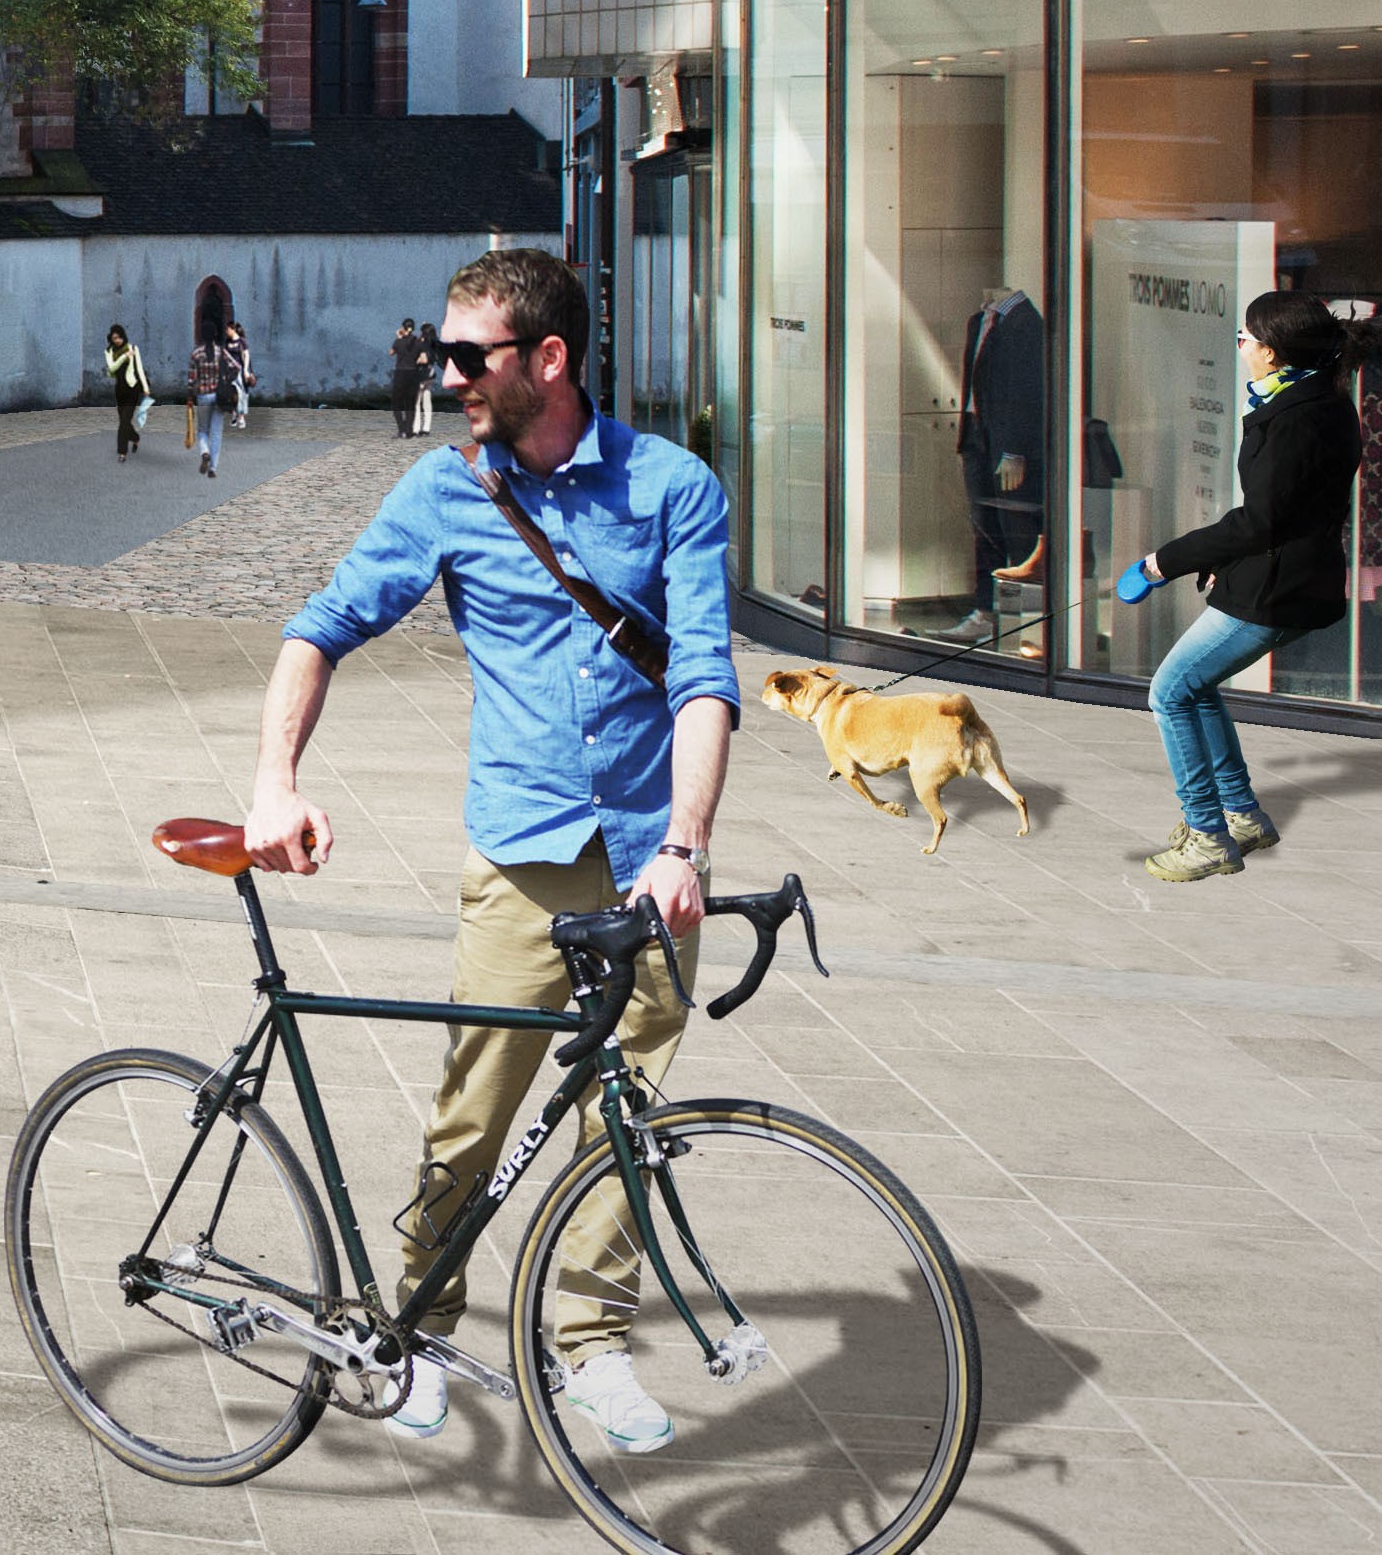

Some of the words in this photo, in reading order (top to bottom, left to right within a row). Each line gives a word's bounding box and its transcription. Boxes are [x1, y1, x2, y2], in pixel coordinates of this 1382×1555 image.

[1152, 274, 1191, 314] POMMES
[1192, 280, 1227, 319] UOMO
[487, 1111, 550, 1202] SURLY
